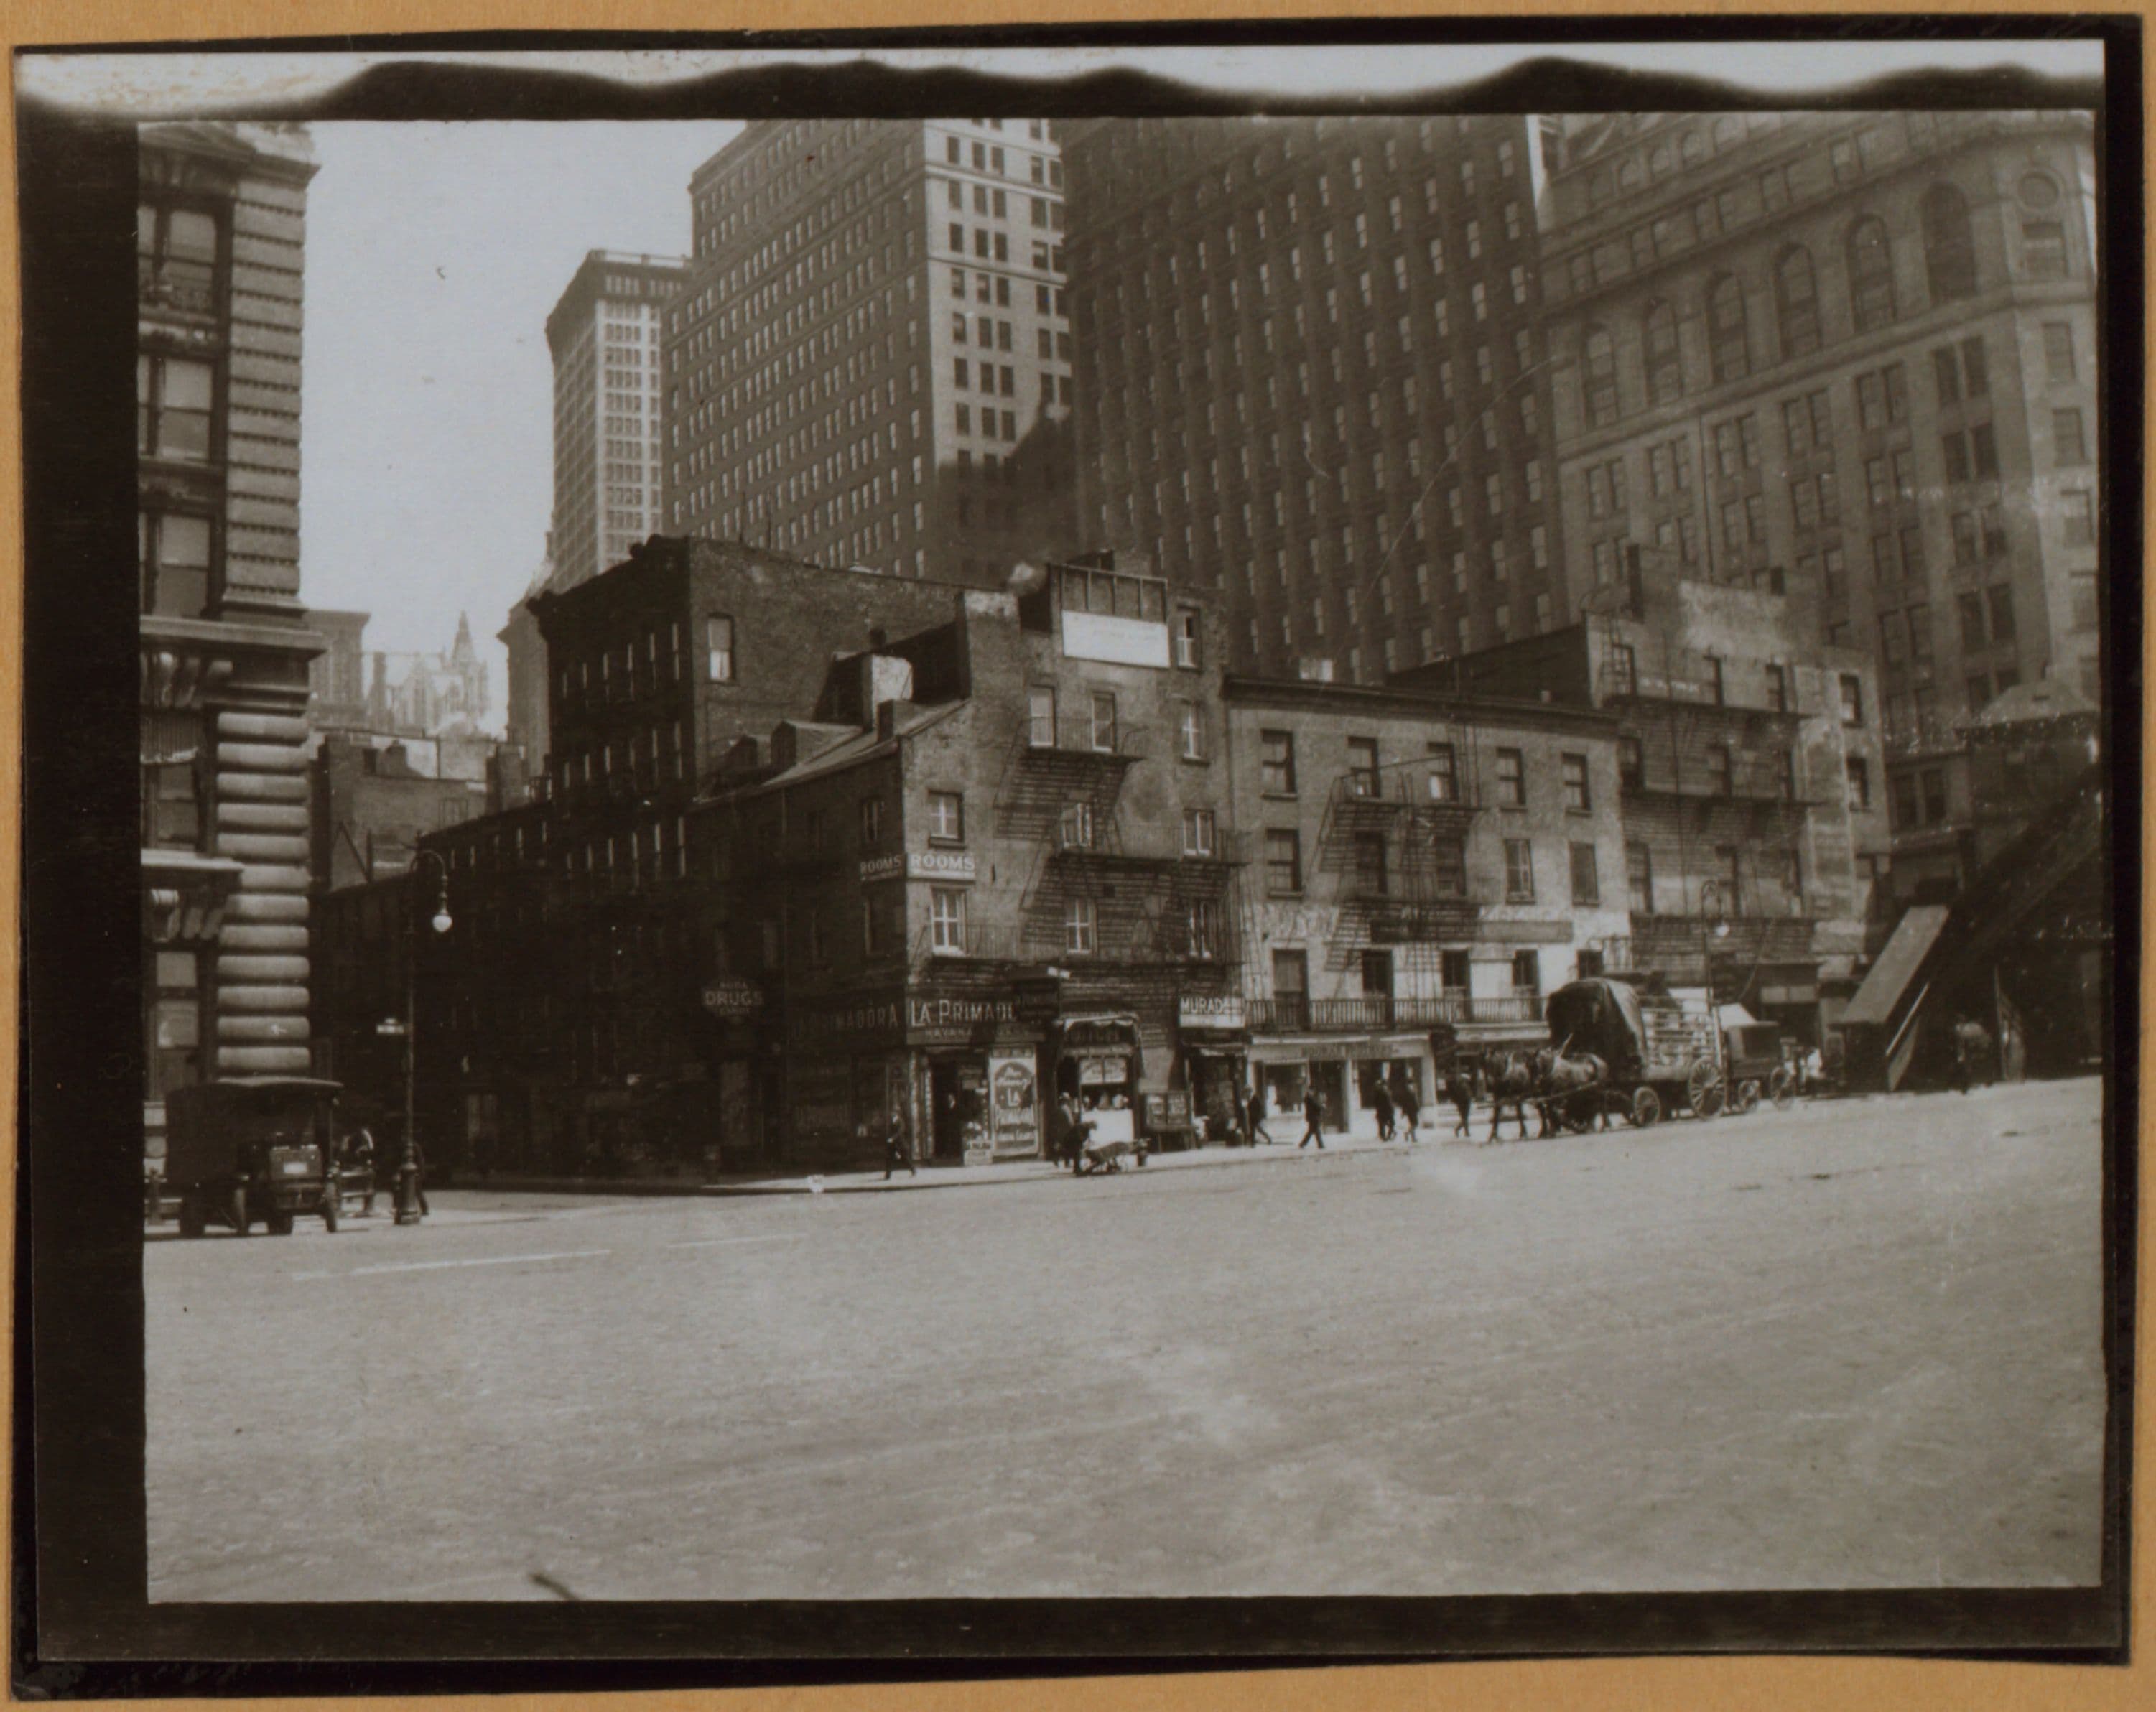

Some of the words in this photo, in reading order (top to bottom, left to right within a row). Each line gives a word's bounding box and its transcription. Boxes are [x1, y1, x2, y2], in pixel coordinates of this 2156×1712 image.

[860, 855, 901, 875] ROOMS
[911, 854, 975, 873] ROOMS
[911, 999, 931, 1028] LA
